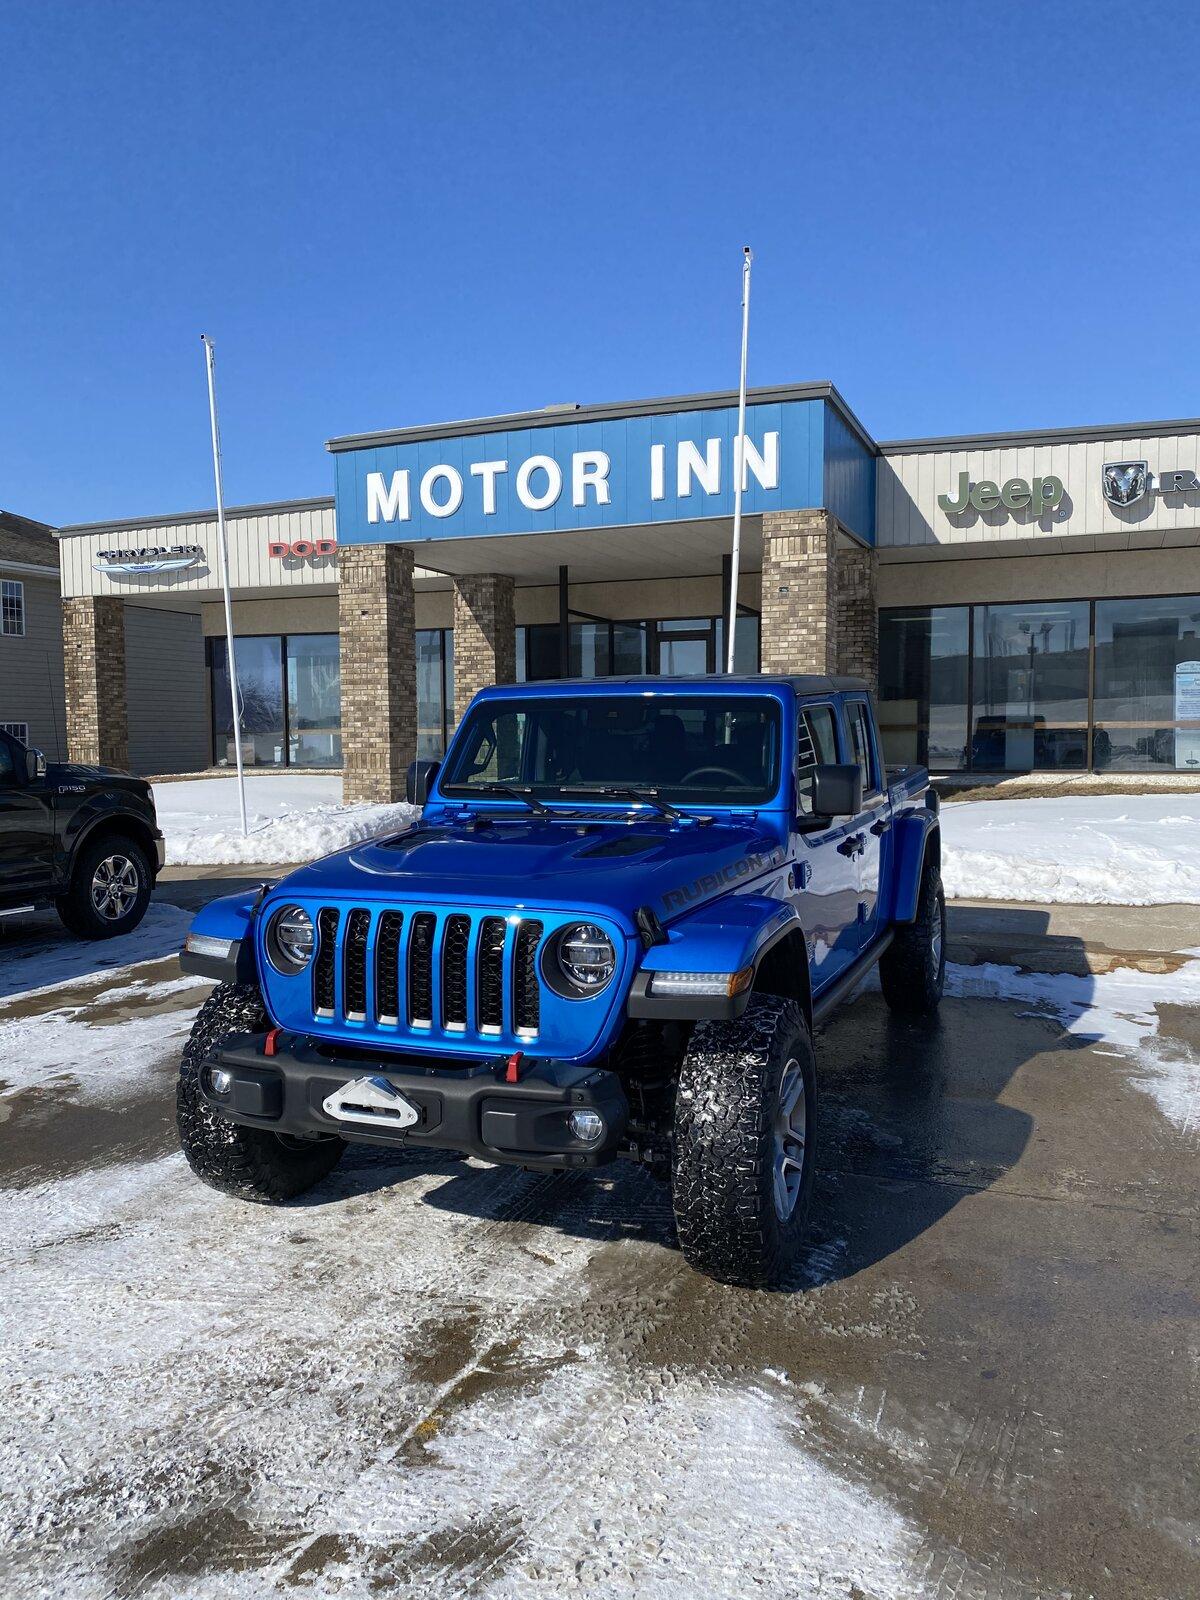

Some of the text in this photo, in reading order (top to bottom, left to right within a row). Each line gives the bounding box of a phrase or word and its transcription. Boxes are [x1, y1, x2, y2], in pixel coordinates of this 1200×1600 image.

[366, 431, 780, 524] MOTOR INN
[937, 471, 1064, 516] Jeep
[1159, 469, 1200, 493] R
[96, 544, 200, 559] CHRYSLER
[661, 852, 765, 911] RUBICON
